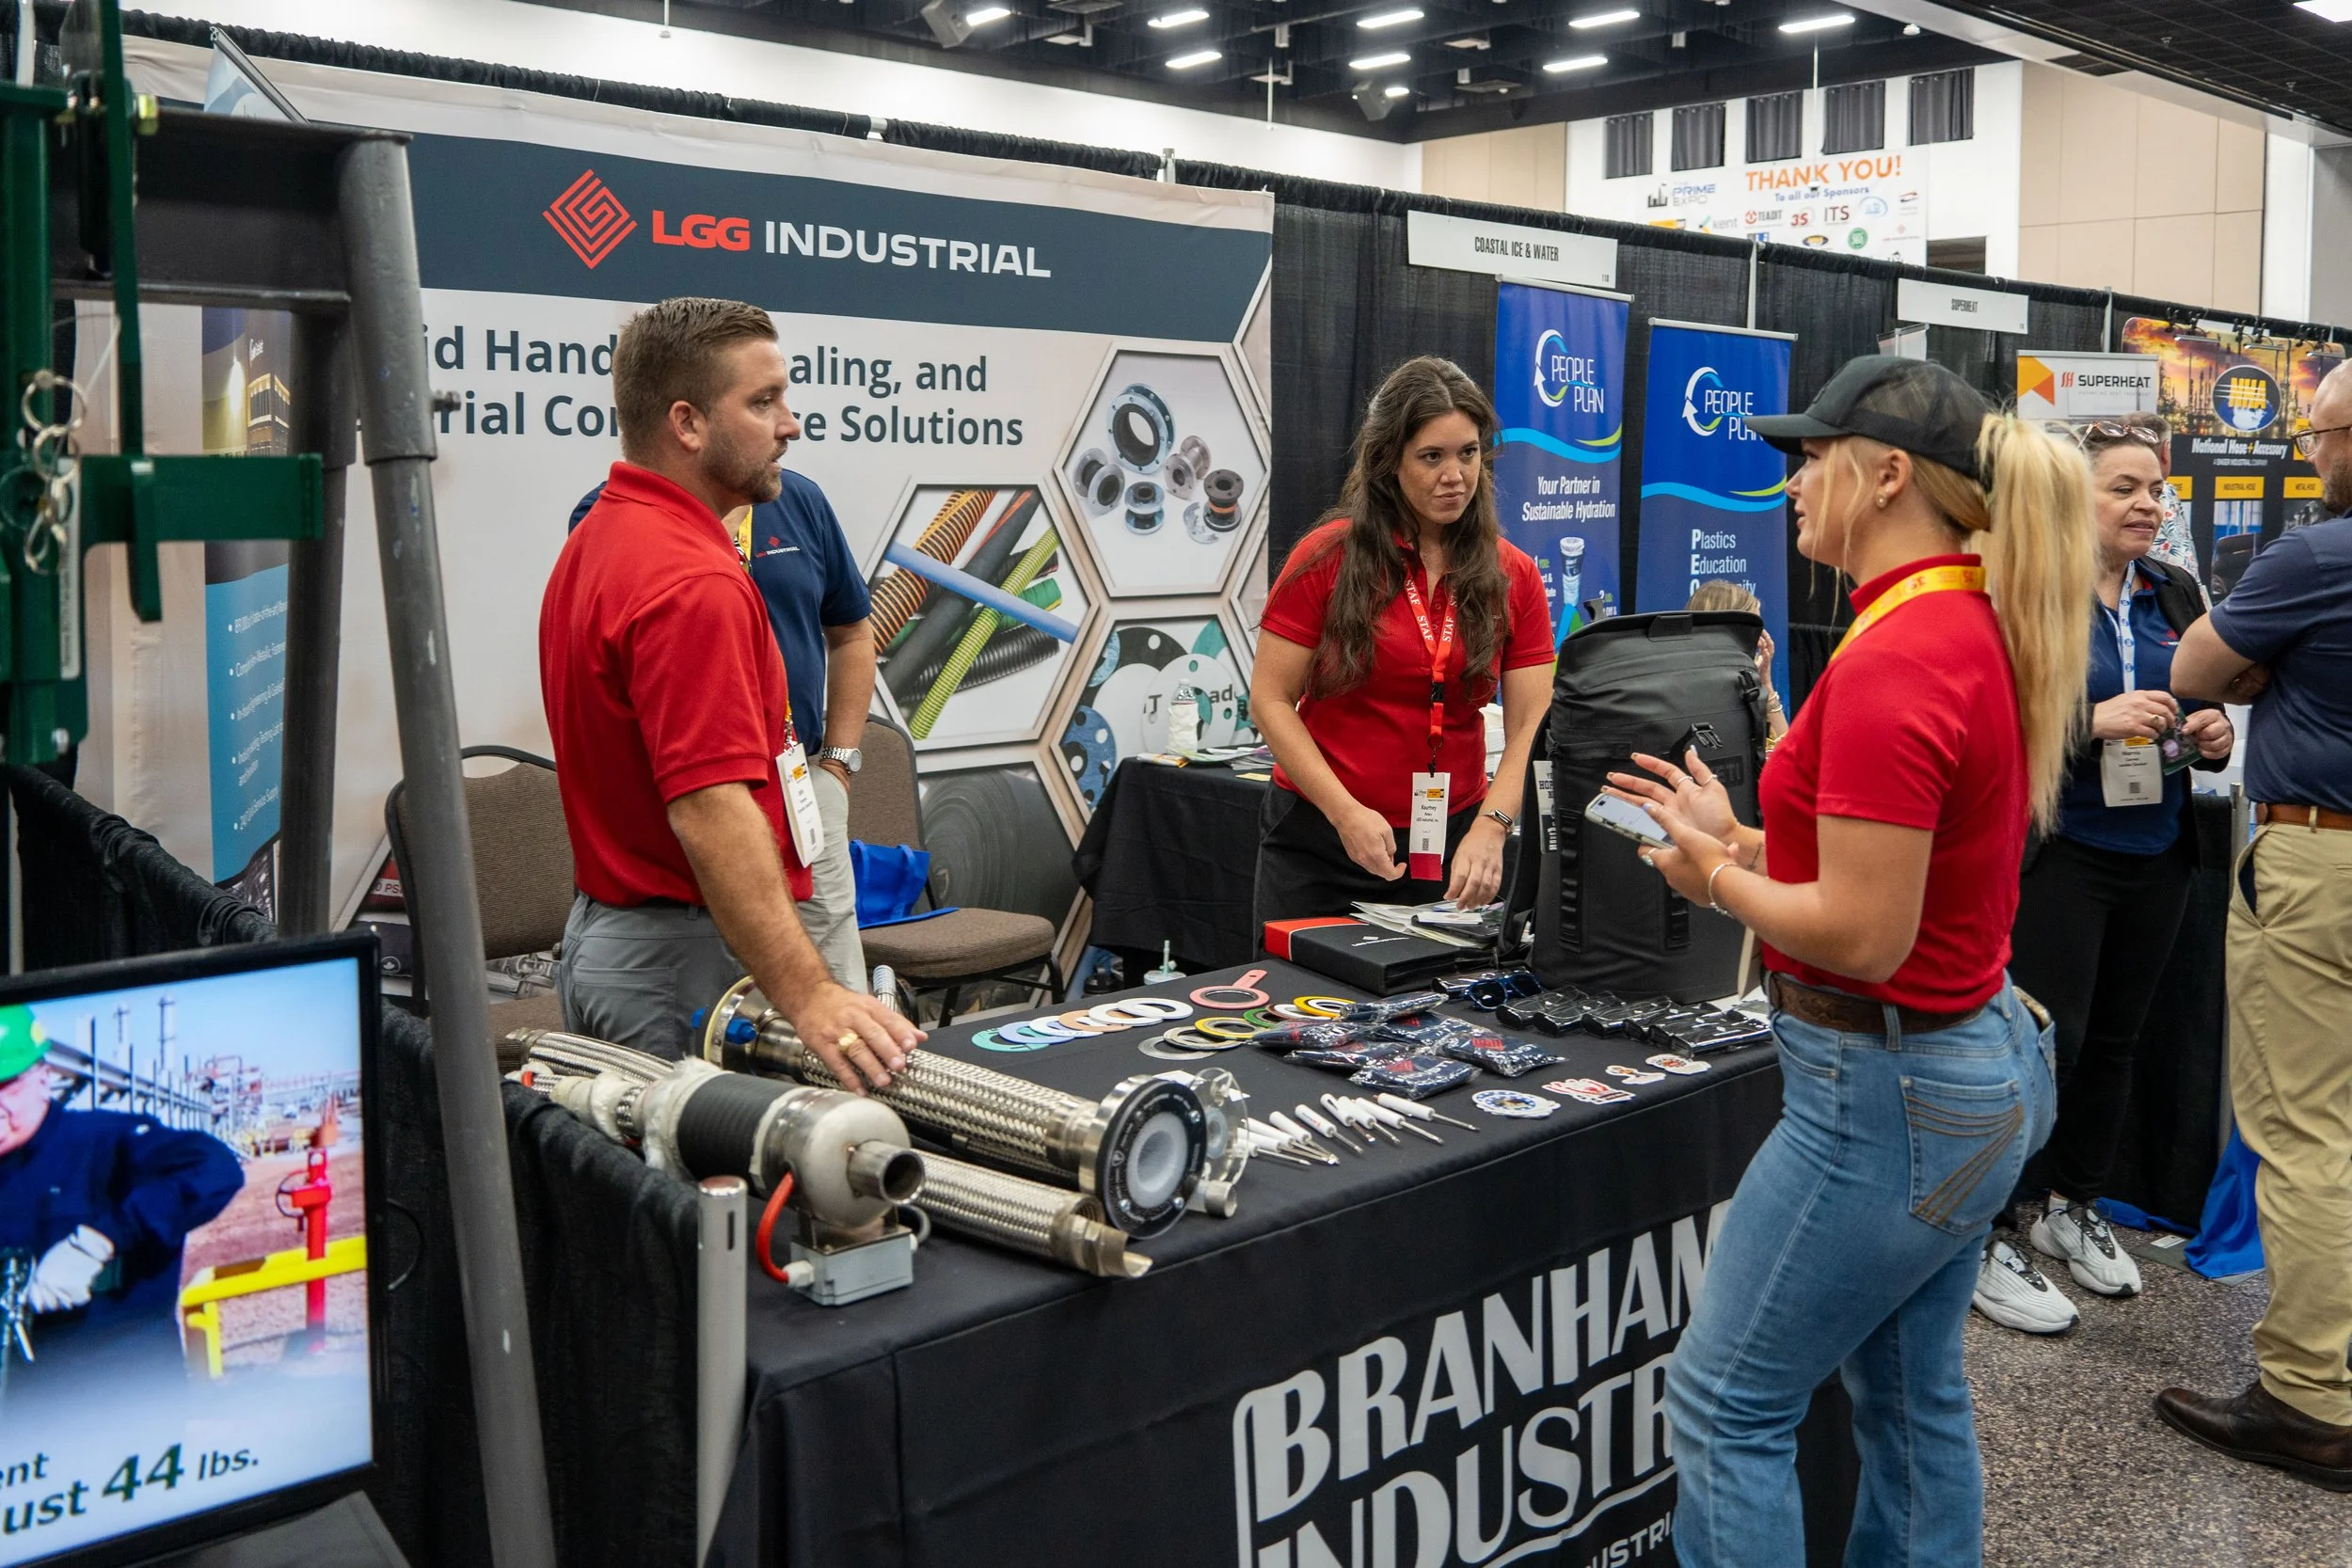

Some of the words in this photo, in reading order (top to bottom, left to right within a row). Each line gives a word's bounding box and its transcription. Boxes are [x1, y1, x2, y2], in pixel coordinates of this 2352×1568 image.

[1745, 163, 1830, 192] THANK
[1838, 154, 1901, 182] YOU!
[1673, 183, 1716, 197] PRIME
[1673, 196, 1708, 207] EXPO
[1775, 193, 1786, 202] To
[1788, 191, 1802, 200] all
[1823, 186, 1869, 201] Sponsors
[1713, 218, 1738, 230] kent
[1824, 205, 1851, 223] ITS
[652, 210, 751, 253] LGG
[765, 219, 1052, 279] INDUSTRIAL
[1474, 236, 1509, 256] COASTAL
[1511, 241, 1523, 258] ICE
[1525, 243, 1532, 259] &
[1533, 244, 1560, 262] WATER
[1951, 297, 1979, 313] SUPERHEAT
[915, 356, 987, 393] and
[1551, 354, 1595, 387] PEOPLE
[2078, 374, 2152, 388] SUPERHEAT
[1574, 387, 1604, 414] PLAN
[1704, 388, 1754, 416] PEOPLE
[840, 404, 1024, 447] Solutions
[2191, 437, 2228, 454] National
[2228, 439, 2248, 455] Hose
[2252, 439, 2288, 460] Accessory
[1538, 476, 1558, 495] Your
[1559, 475, 1591, 495] Partner
[1592, 477, 1601, 494] in
[1521, 500, 1574, 523] Sustainable
[1575, 500, 1616, 524] Hydration
[1691, 528, 1737, 550] Plastics
[1690, 553, 1747, 576] Education
[1234, 1198, 1737, 1524] BRANHAM
[101, 1443, 185, 1503] 44
[197, 1449, 259, 1481] lbs.
